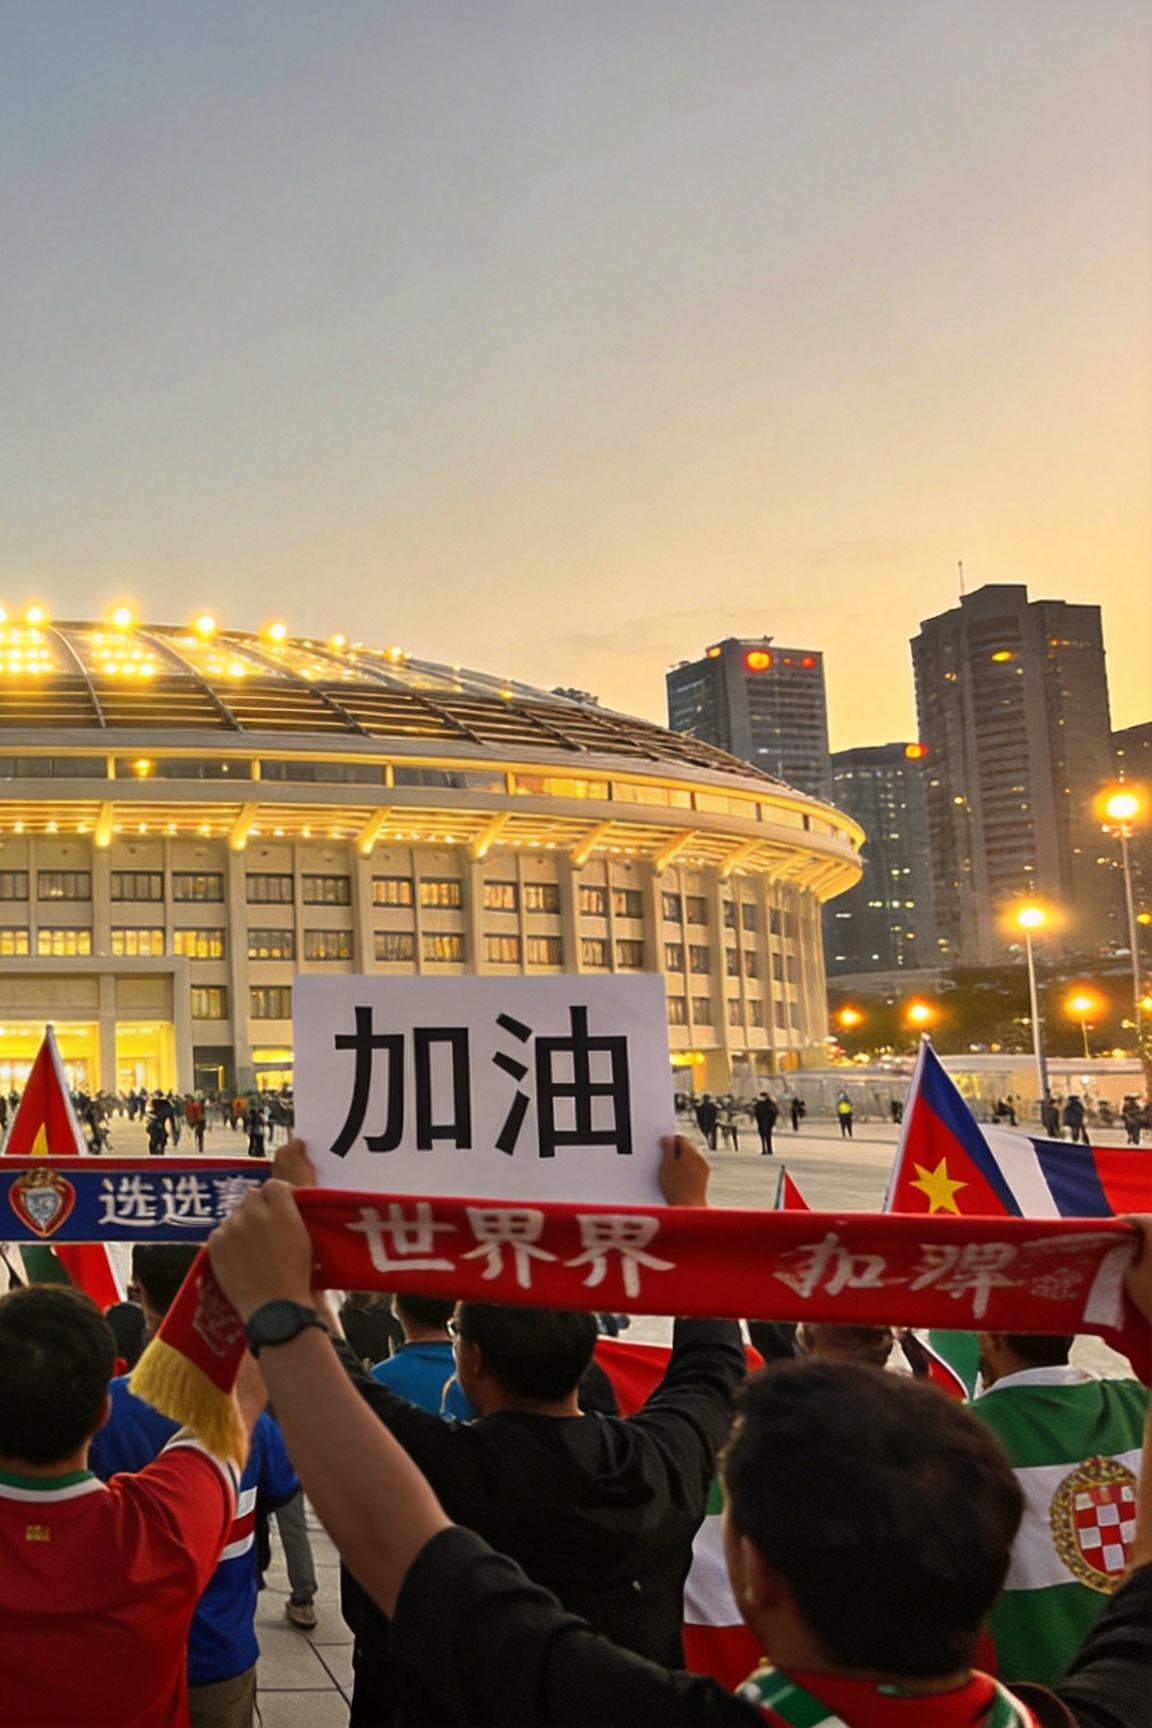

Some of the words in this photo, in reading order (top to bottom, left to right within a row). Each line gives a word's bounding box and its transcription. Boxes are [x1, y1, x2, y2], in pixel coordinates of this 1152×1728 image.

[330, 1005, 633, 1159] 加油
[344, 1202, 677, 1299] 世界界
